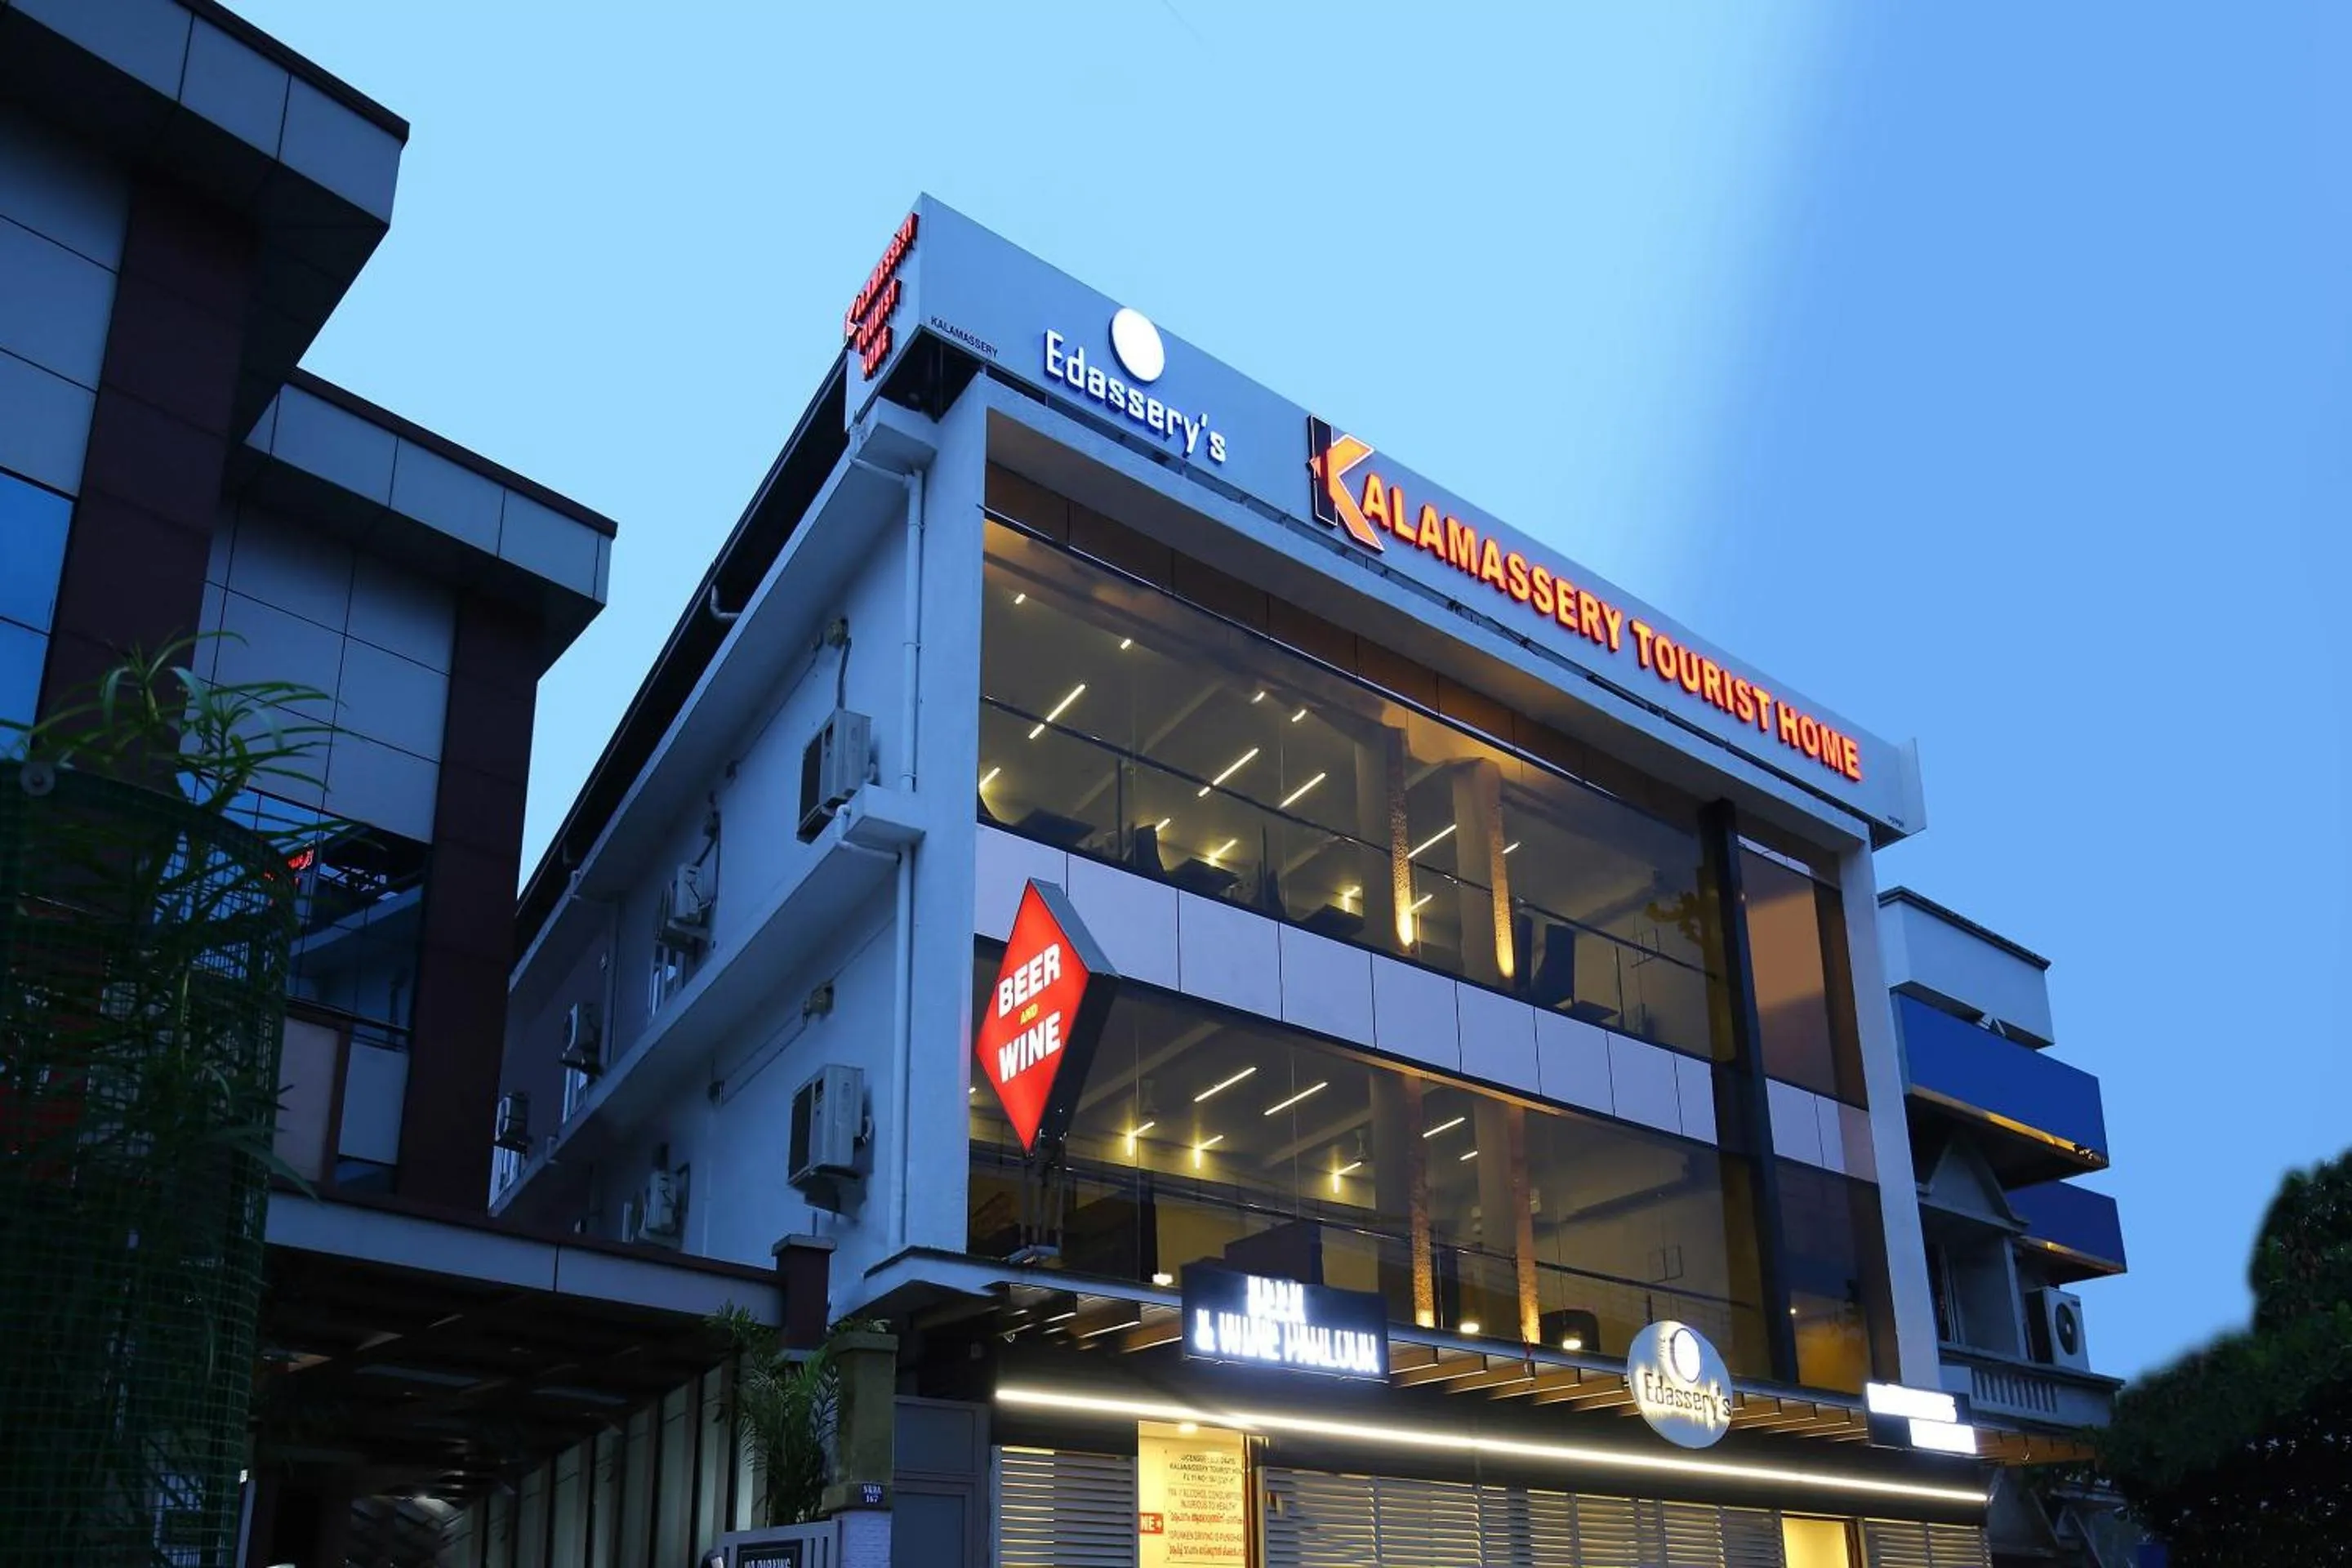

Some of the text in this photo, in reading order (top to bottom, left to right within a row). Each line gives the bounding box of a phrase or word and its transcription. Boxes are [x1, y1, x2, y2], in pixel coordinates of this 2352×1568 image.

[930, 315, 998, 358] KALAMASSERY
[1045, 329, 1226, 463] Edassery's
[1307, 415, 1863, 782] KALAMASSERY TOURIST HOME
[998, 942, 1060, 1018] BEER
[998, 1011, 1061, 1084] WINE
[1644, 1371, 1731, 1420] Edassery's
